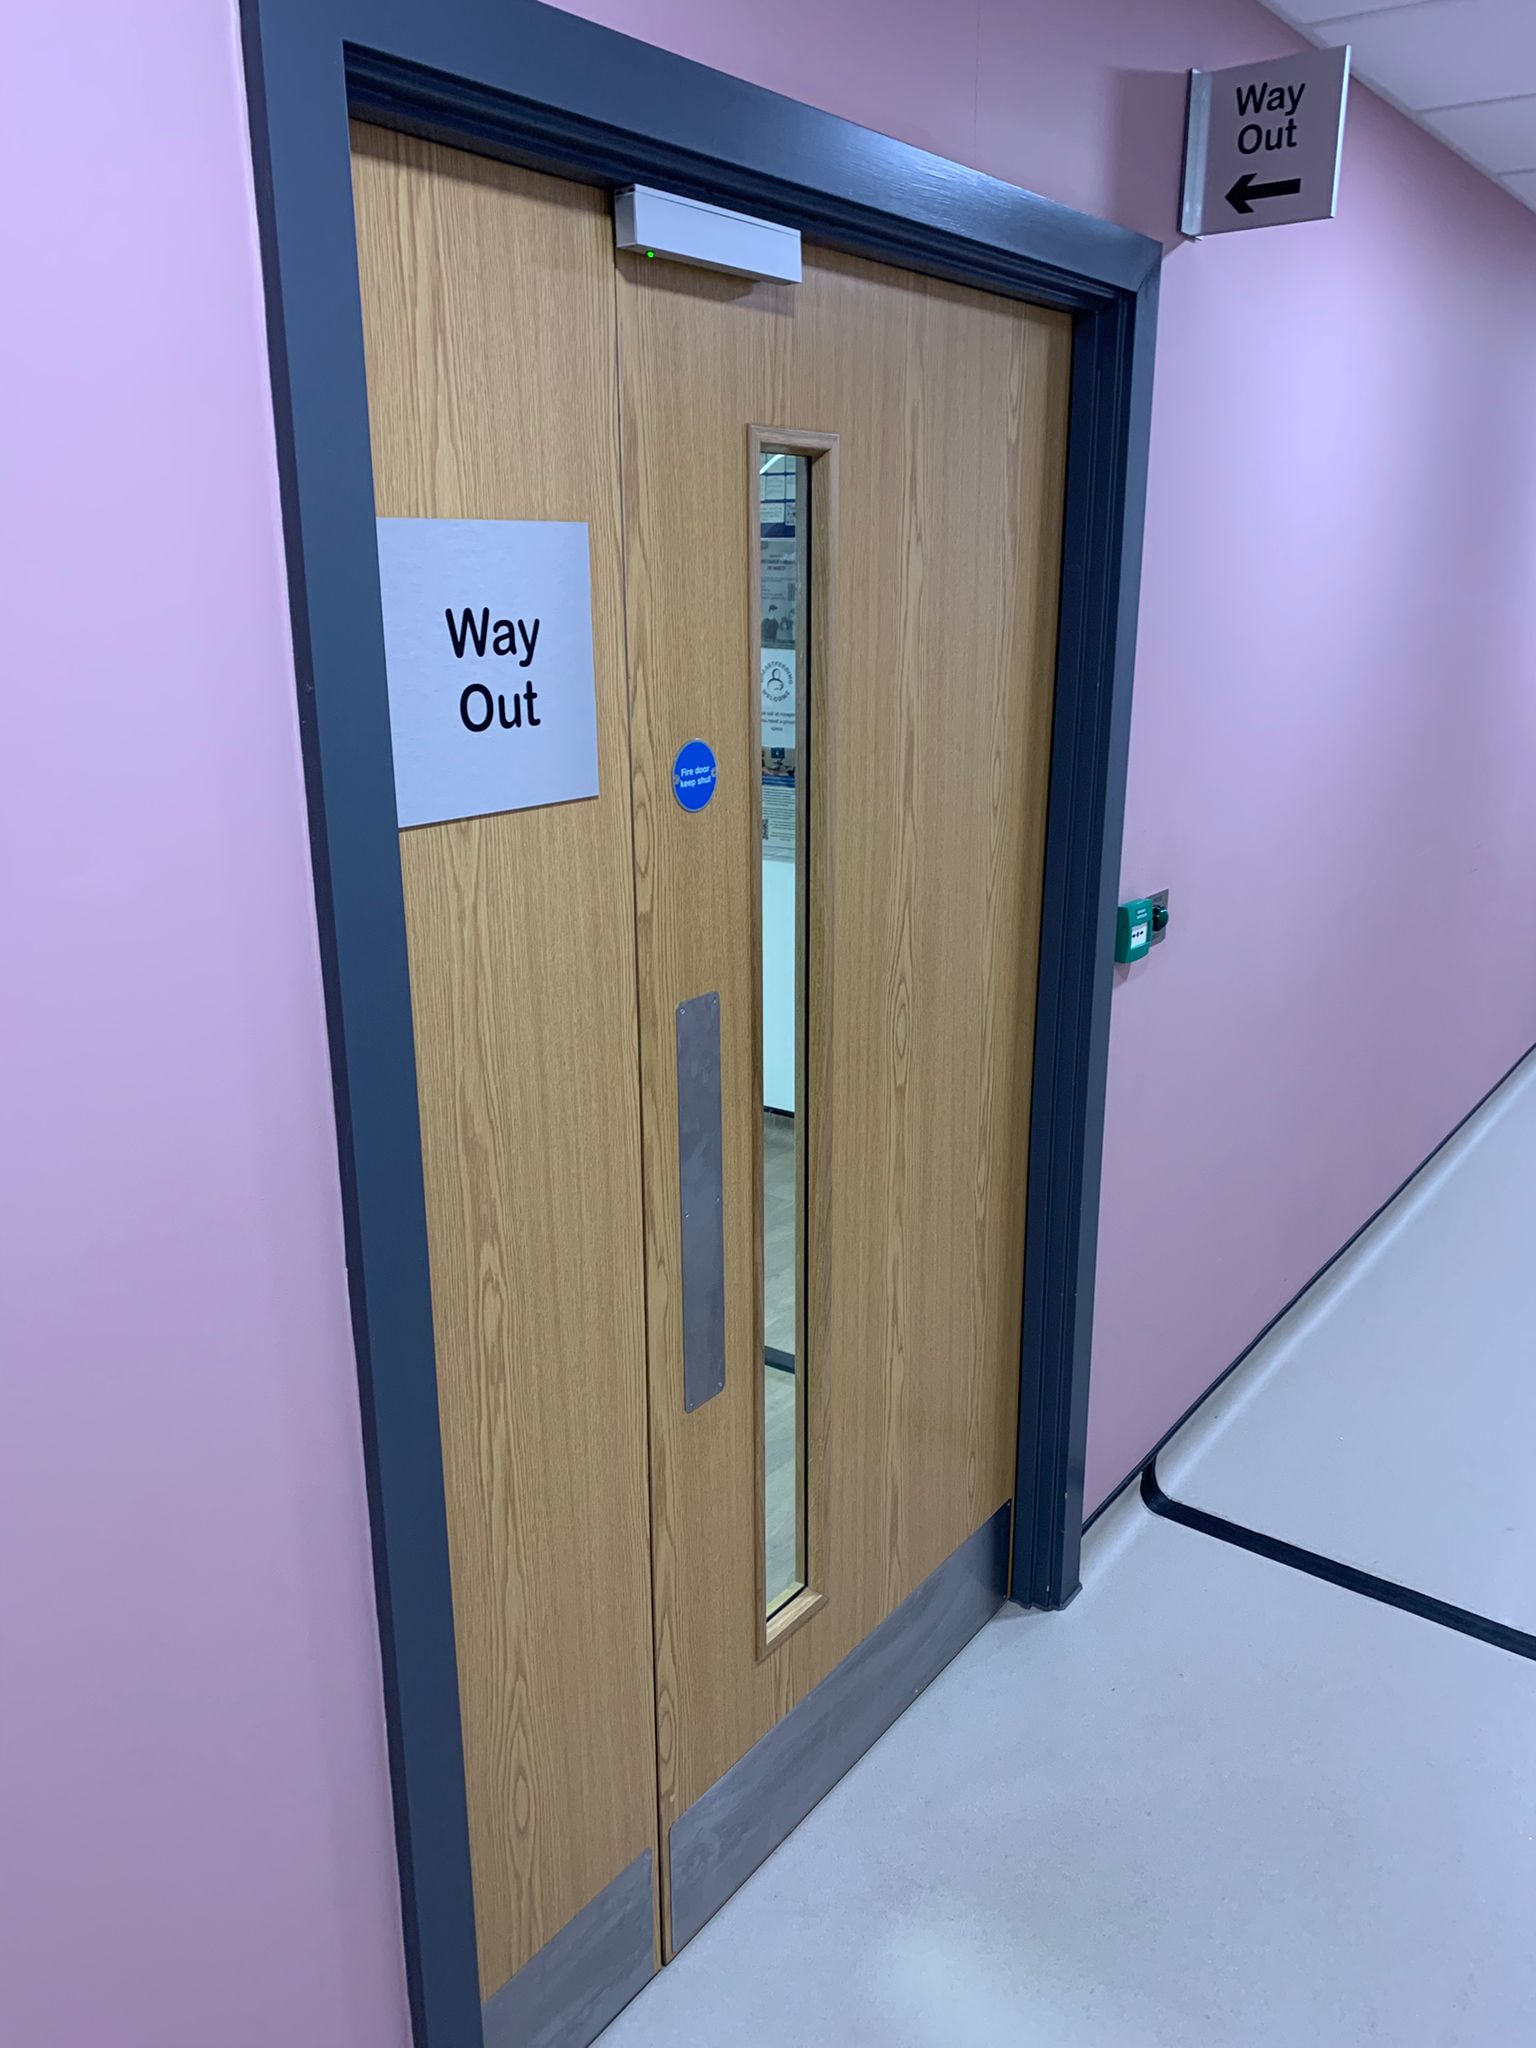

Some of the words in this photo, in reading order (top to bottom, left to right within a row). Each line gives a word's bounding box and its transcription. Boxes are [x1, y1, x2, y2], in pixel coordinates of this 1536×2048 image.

[1236, 82, 1306, 116] Way
[1237, 118, 1298, 154] Out
[445, 607, 540, 667] Way
[459, 680, 541, 732] Out
[680, 779, 696, 788] keep
[697, 775, 711, 785] shut
[681, 768, 694, 776] Fire
[695, 766, 710, 774] door
